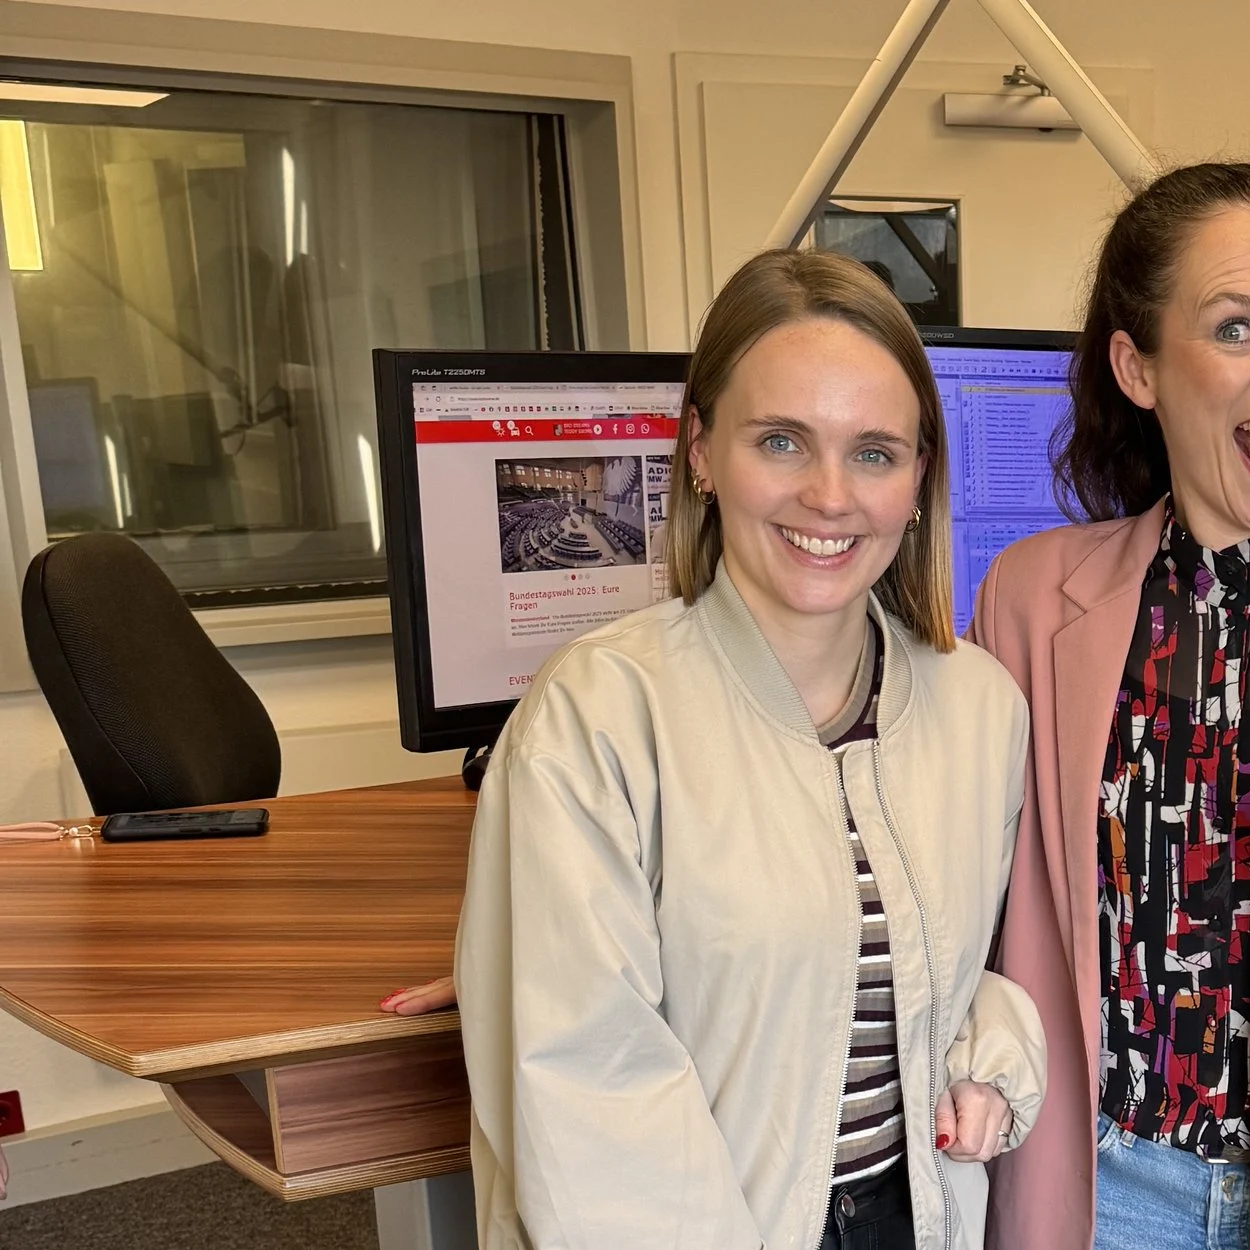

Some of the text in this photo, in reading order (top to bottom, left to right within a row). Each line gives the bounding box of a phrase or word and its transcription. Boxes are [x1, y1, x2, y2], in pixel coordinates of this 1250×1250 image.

[411, 368, 442, 376] ProLite
[509, 588, 574, 601] Bundestagswahl
[602, 585, 620, 594] Eure
[509, 601, 538, 611] Fragen
